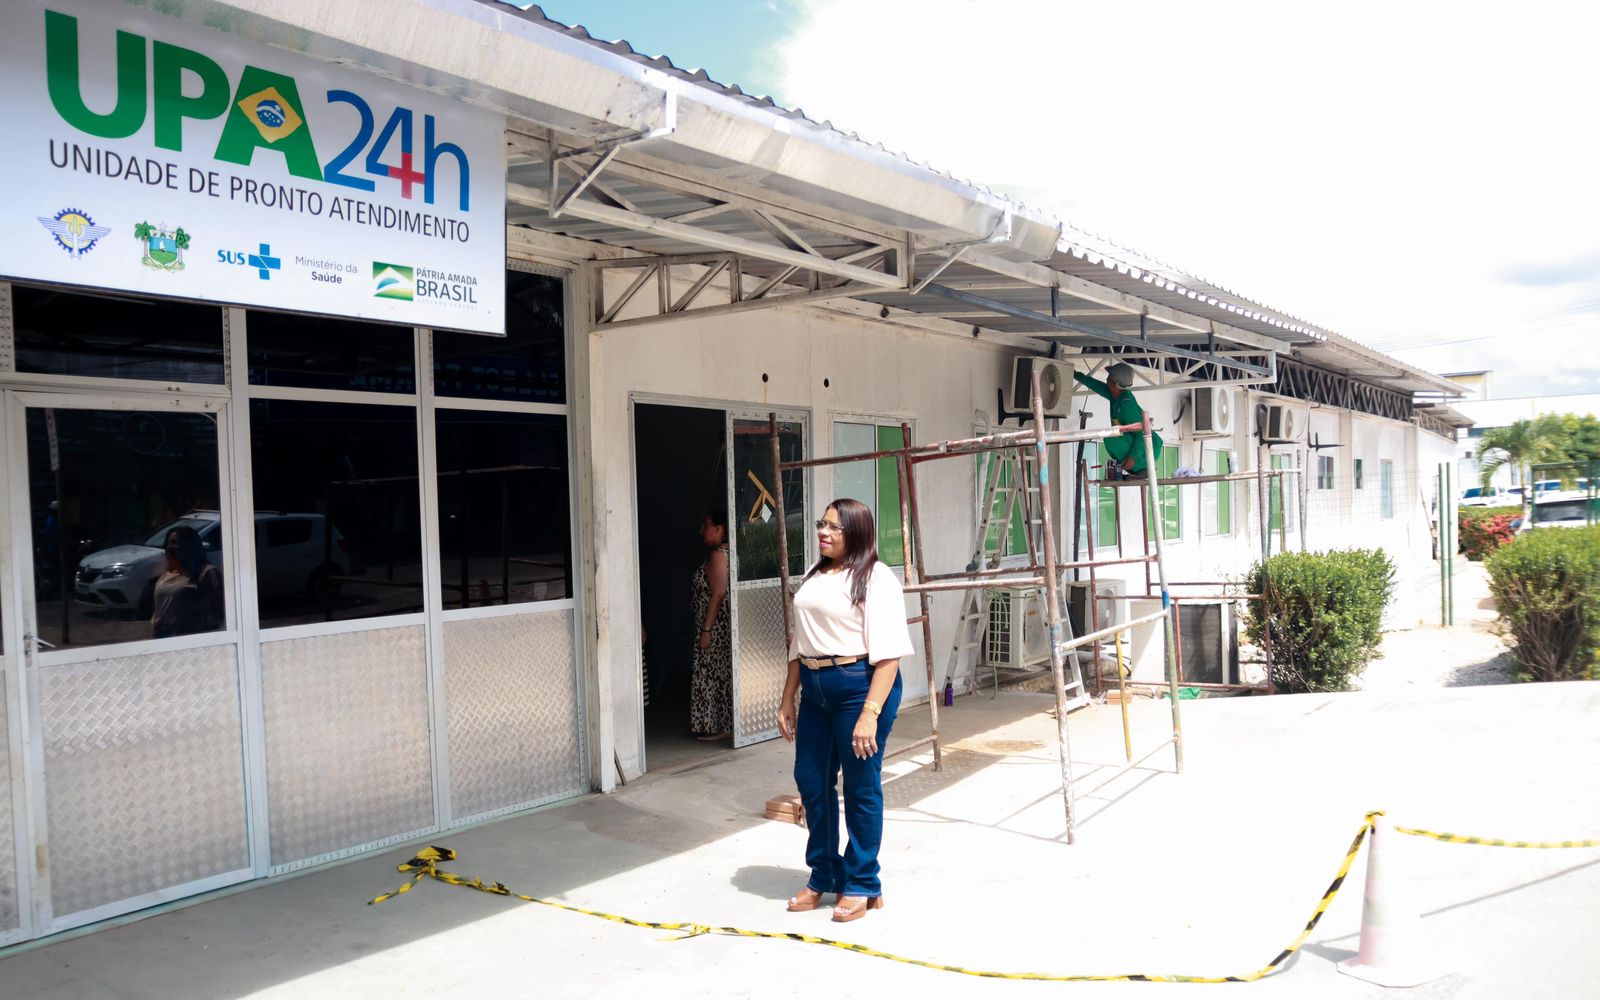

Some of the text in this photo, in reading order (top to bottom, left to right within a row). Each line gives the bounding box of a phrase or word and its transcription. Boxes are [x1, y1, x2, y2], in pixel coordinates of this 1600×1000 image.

[49, 138, 470, 243] UNIDADE DE PRONTO ATENDIMENTO
[217, 249, 246, 266] SUS
[295, 255, 358, 274] Ministério da
[311, 271, 343, 284] Saúde
[416, 266, 478, 286] PÁTRIA AMADA
[416, 279, 477, 304] BRASIL
